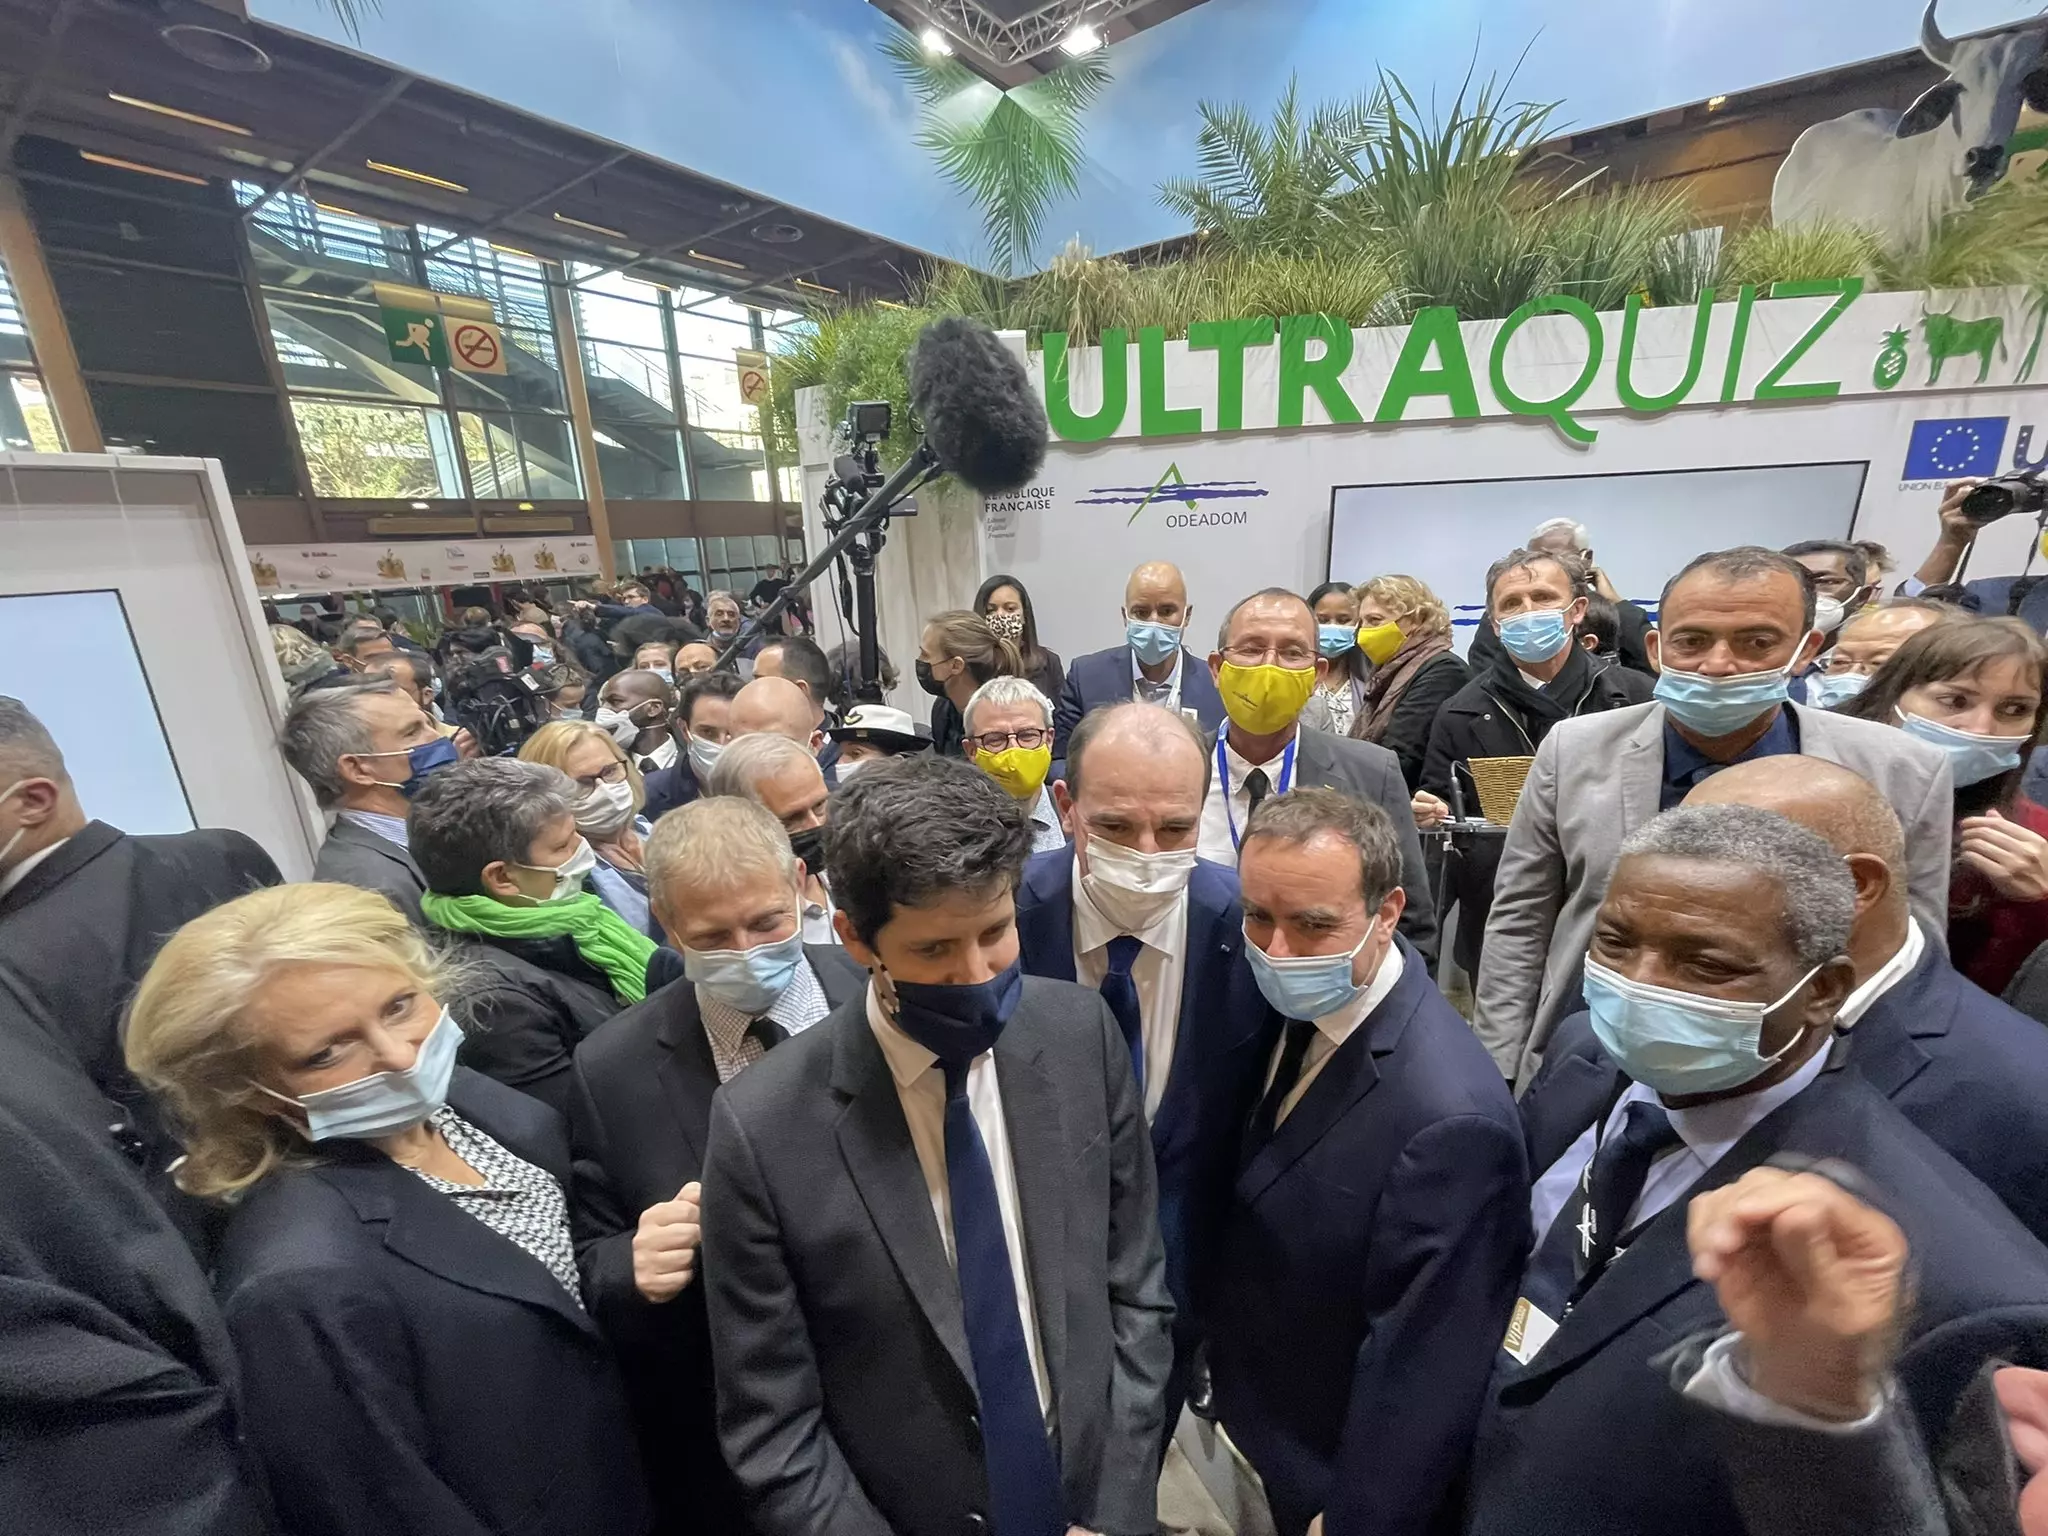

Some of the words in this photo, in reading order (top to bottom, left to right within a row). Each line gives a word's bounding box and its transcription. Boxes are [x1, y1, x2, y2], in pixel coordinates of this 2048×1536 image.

[1042, 276, 1864, 443] ULTRAQUIZ
[984, 486, 1056, 501] UBLIQUE
[985, 499, 1051, 513] FRANÇAISE
[1166, 511, 1247, 528] ODEADOM
[1507, 1321, 1524, 1346] VIP
